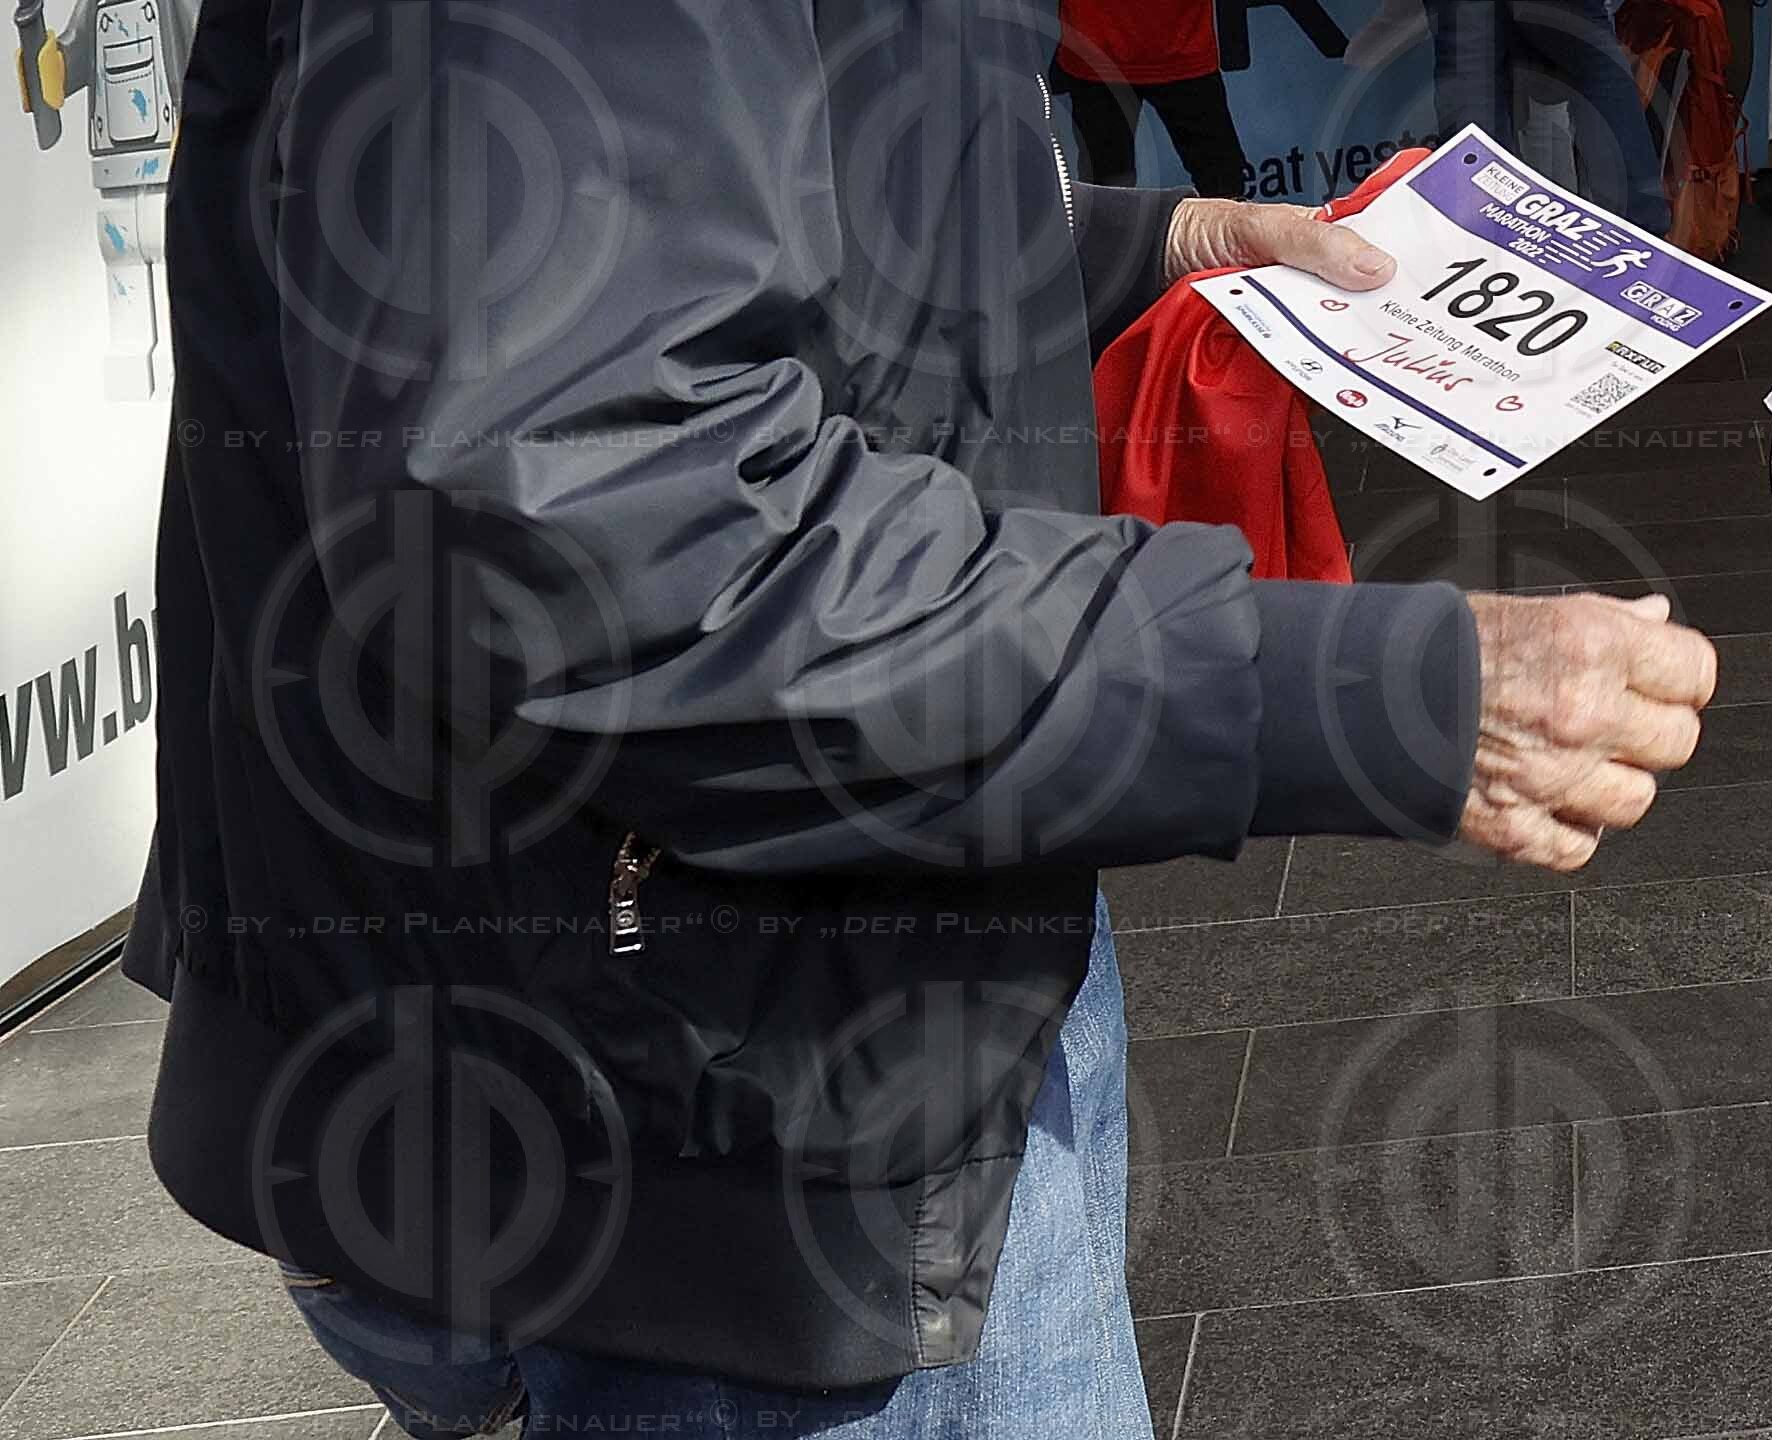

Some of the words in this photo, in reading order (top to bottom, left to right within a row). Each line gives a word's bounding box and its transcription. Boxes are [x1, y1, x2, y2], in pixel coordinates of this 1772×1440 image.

[1487, 166, 1525, 195] KLEINE
[1480, 202, 1551, 243] MARATHON
[1515, 193, 1602, 241] GRAZ
[1509, 238, 1544, 259] 2022
[1421, 258, 1588, 357] 1820
[1624, 283, 1699, 326] GRAZ
[1379, 299, 1418, 326] Kleine
[1415, 320, 1462, 353] Zeitung
[1462, 344, 1522, 383] Marathon
